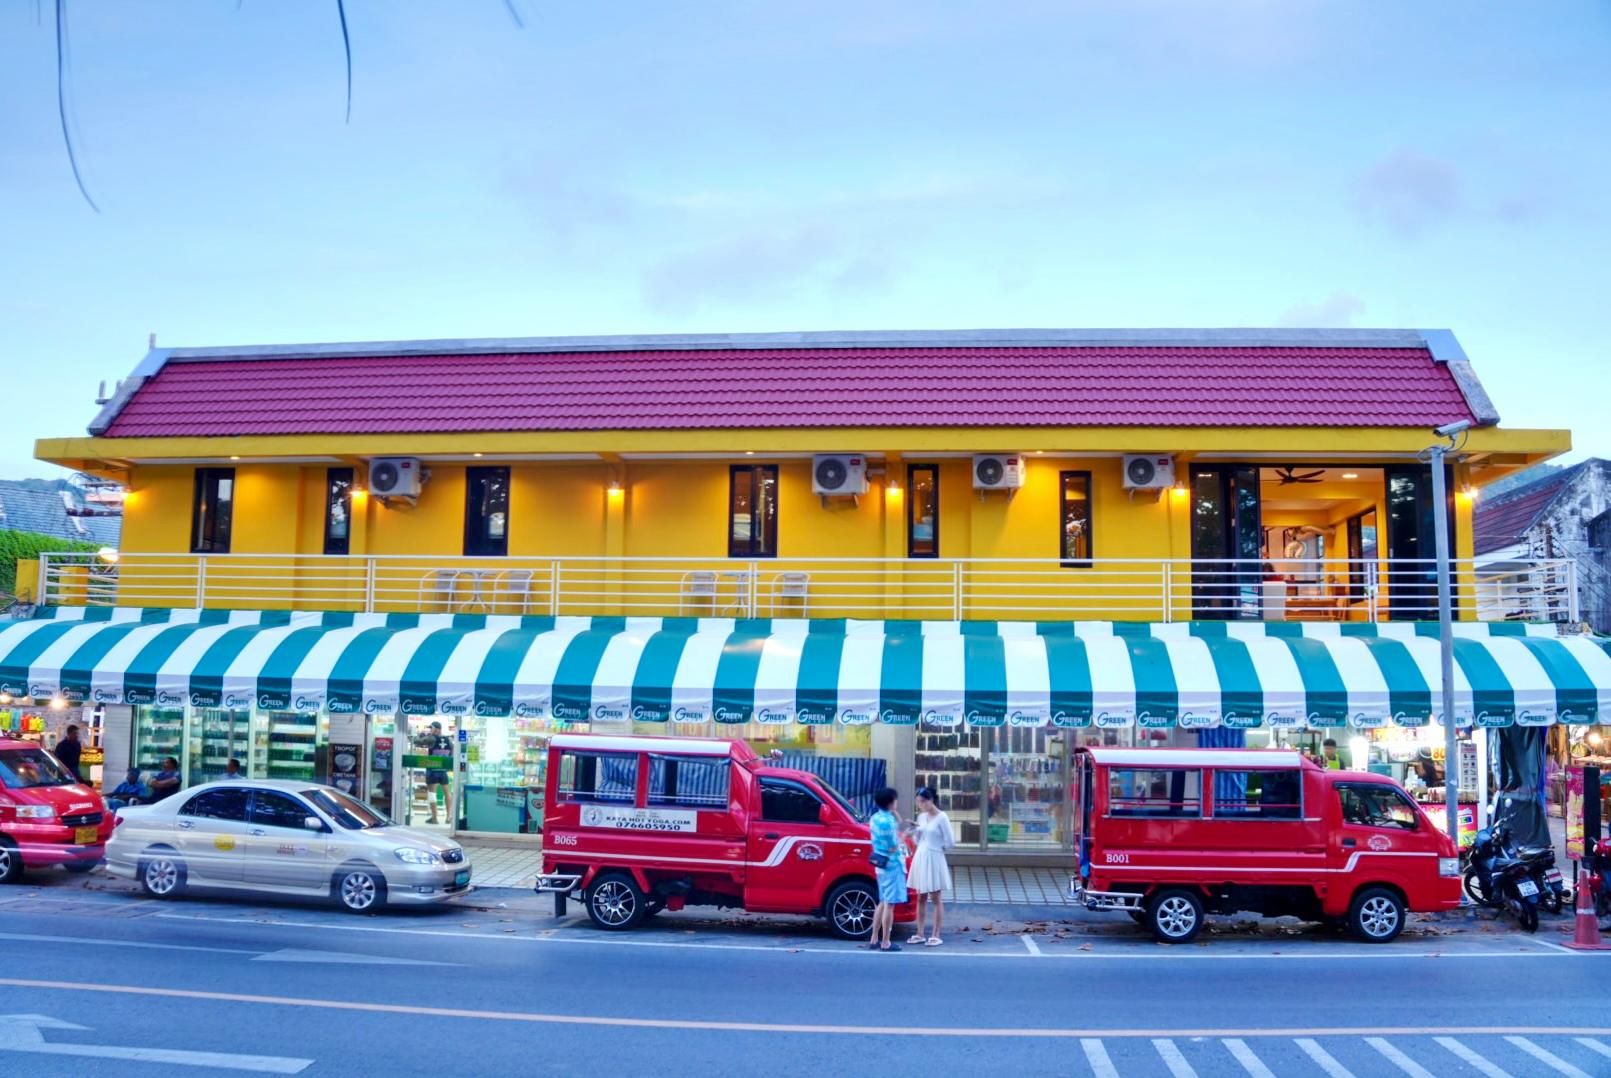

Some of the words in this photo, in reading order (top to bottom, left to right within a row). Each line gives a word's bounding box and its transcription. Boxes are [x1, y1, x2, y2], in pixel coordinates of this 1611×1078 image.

[616, 821, 680, 831] 076605950
[554, 835, 577, 845] B065
[1106, 853, 1129, 863] B001
